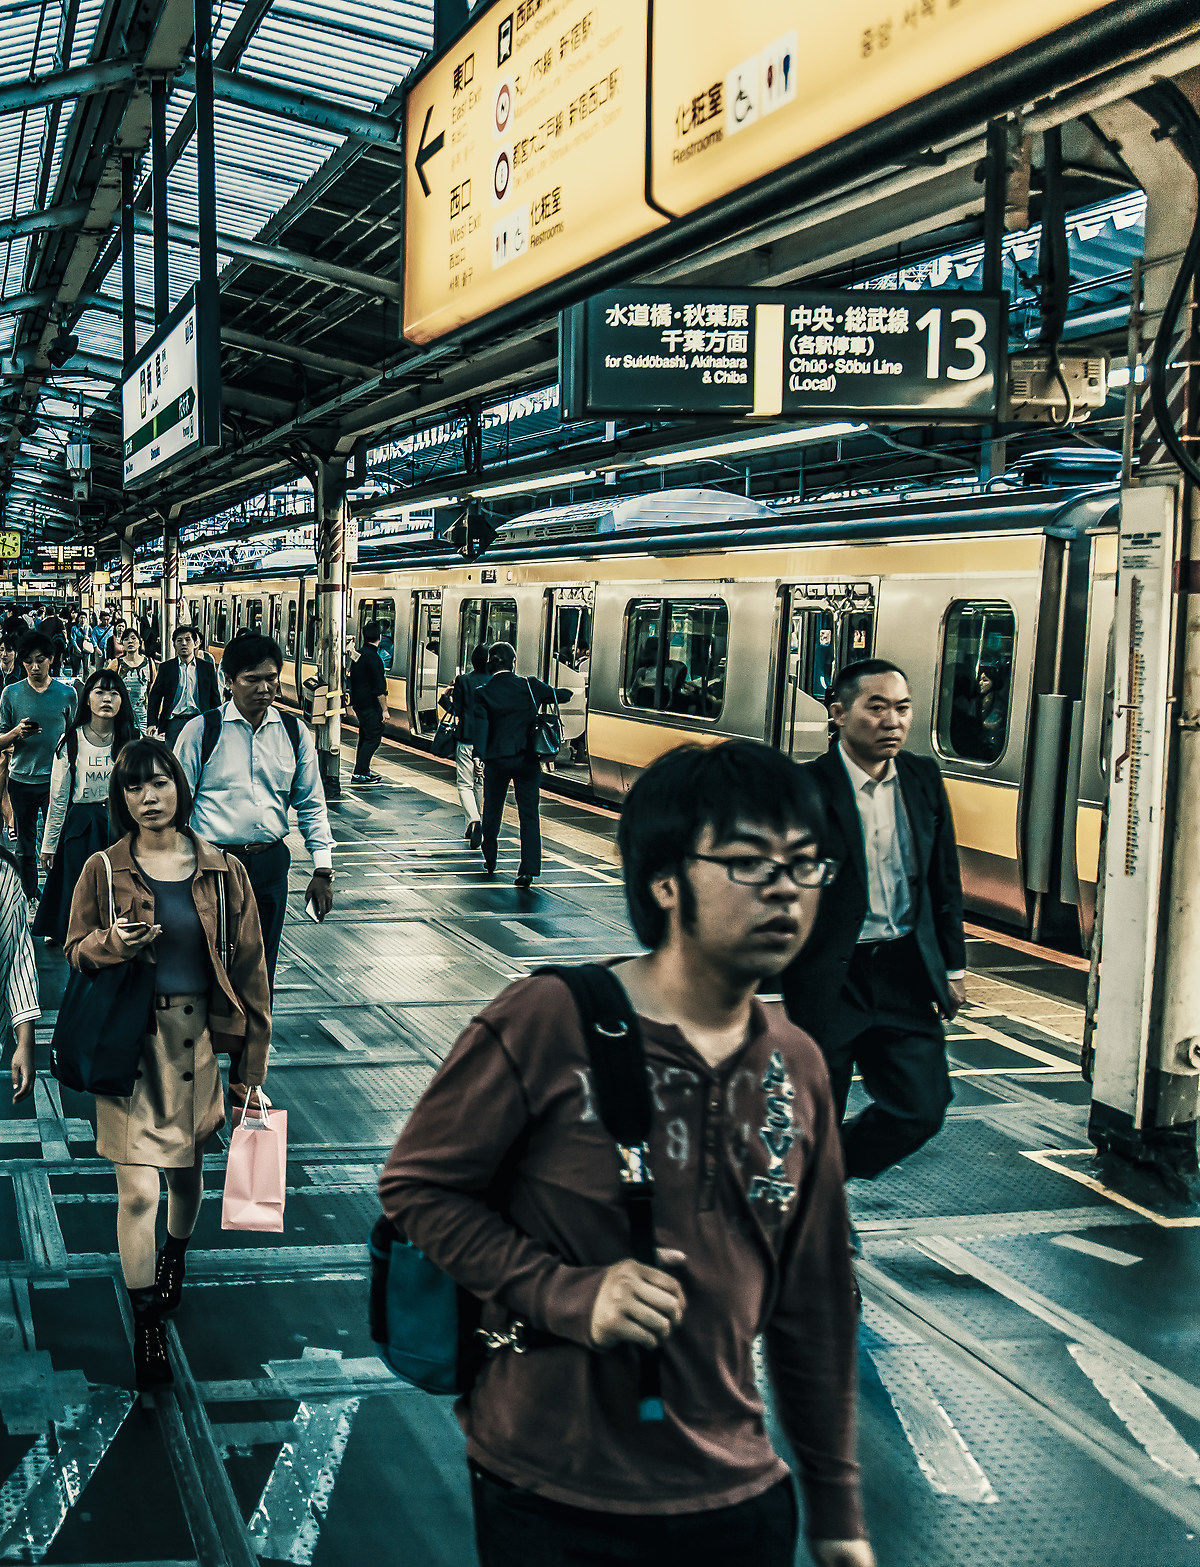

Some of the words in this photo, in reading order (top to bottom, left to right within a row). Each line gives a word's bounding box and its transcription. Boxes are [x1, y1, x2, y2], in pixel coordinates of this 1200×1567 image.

[452, 51, 475, 99] 東口
[674, 81, 724, 140] 化粧室
[672, 127, 724, 166] Restrooms
[450, 177, 472, 220] 西口
[529, 185, 562, 227] 化粧室
[529, 222, 564, 248] Restrooms
[604, 304, 750, 328] 水道橋・秋葉原
[789, 305, 910, 334] 中央・総武線
[660, 330, 749, 354] 千葉方面
[914, 308, 987, 381] 13
[605, 355, 621, 369] for
[691, 355, 748, 370] Akihabara
[874, 359, 903, 375] Line
[702, 370, 713, 384] &
[714, 370, 748, 384] Chiba
[789, 375, 836, 393] (Local)
[82, 545, 95, 558] 13
[85, 771, 112, 782] MAK
[82, 787, 109, 798] EVE
